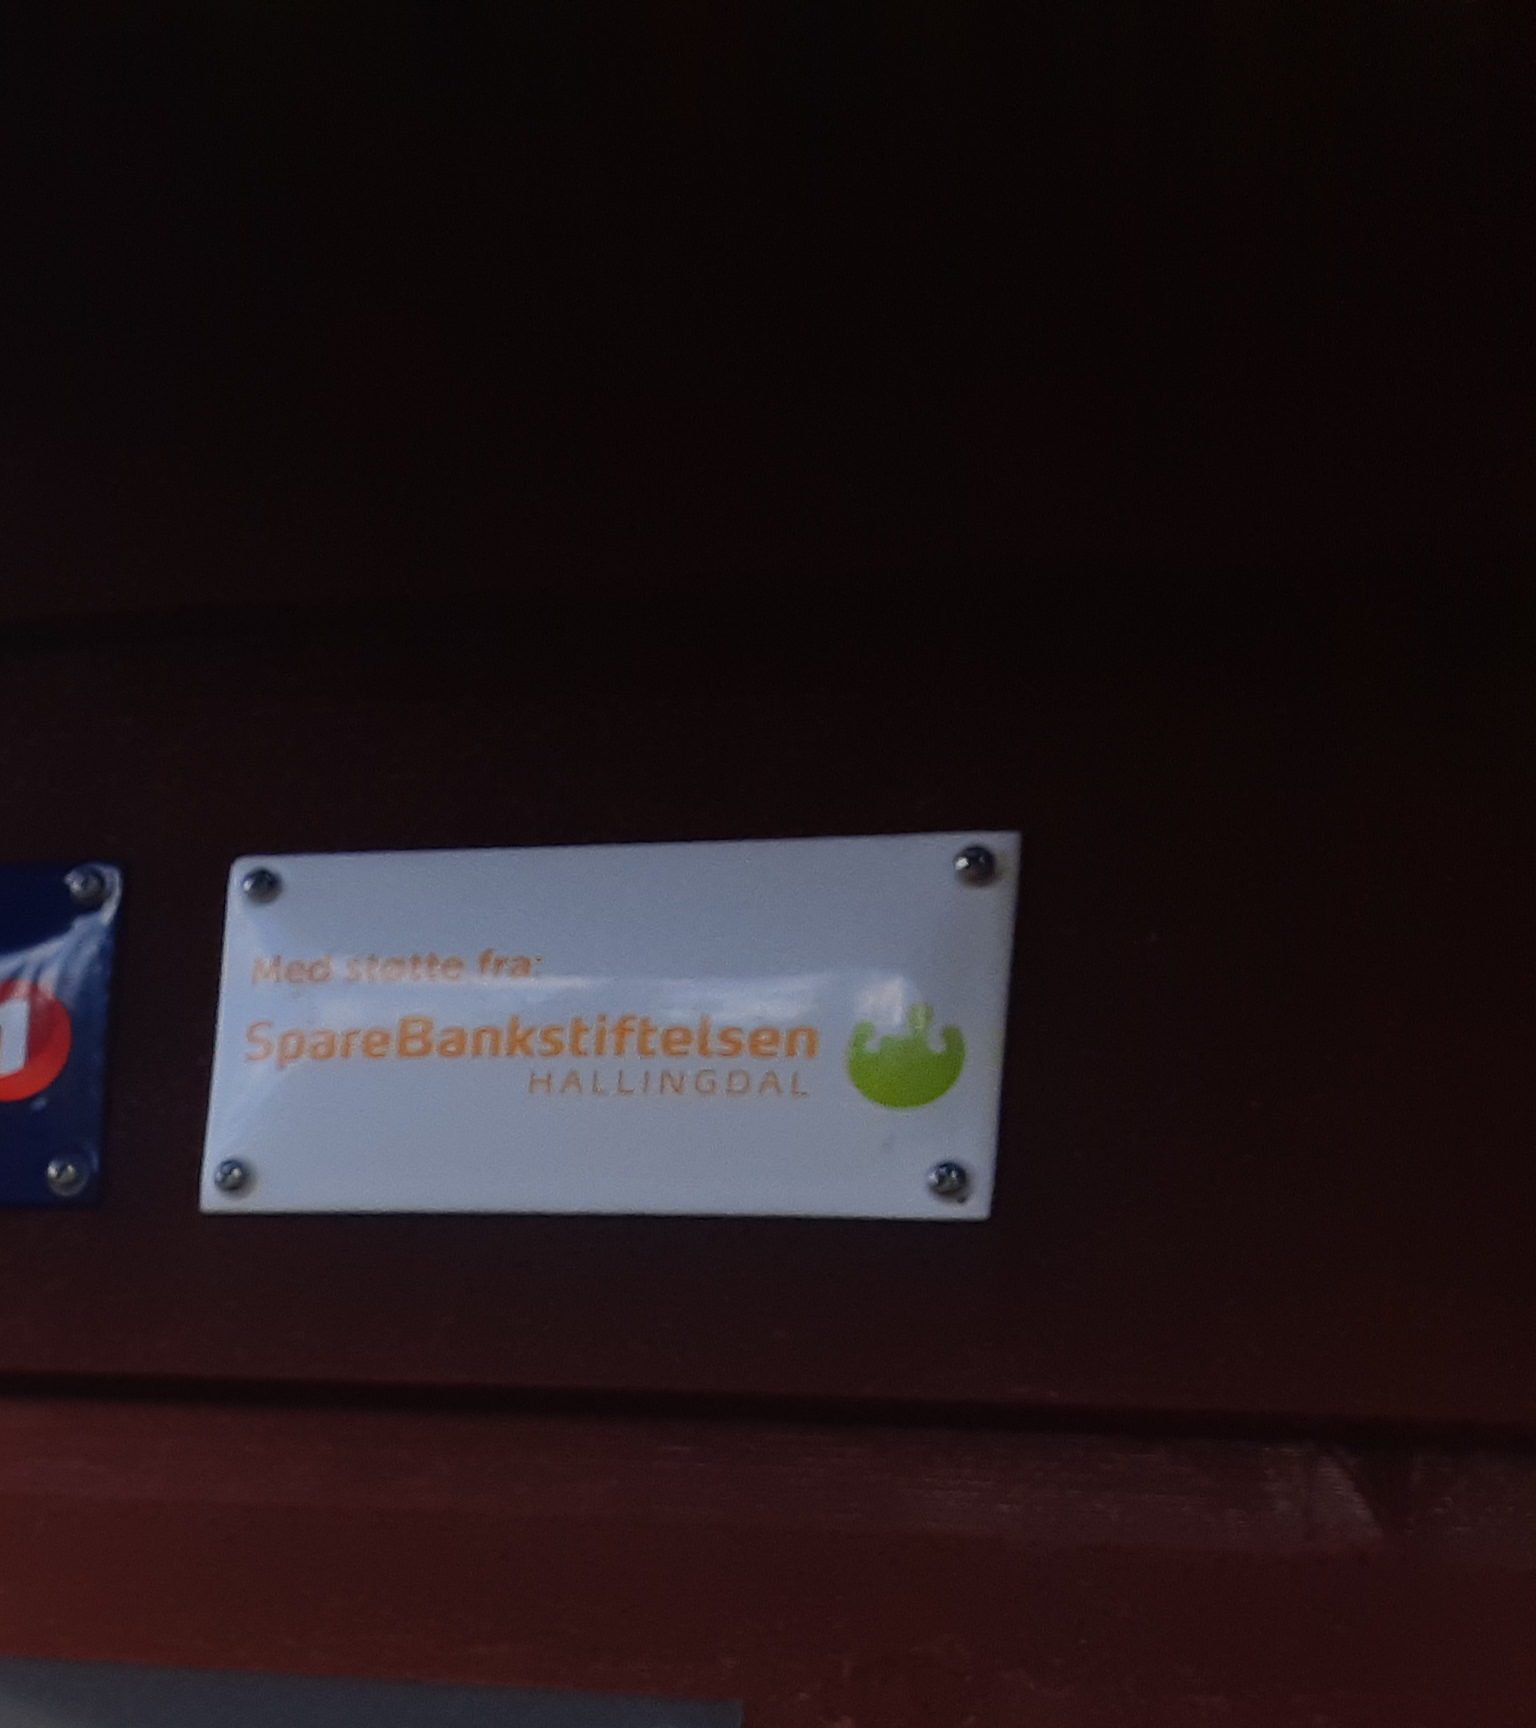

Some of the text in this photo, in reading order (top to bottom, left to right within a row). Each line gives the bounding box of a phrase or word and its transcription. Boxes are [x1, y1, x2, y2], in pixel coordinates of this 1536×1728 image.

[251, 955, 329, 986] Med
[345, 951, 465, 983] støtte
[244, 1013, 819, 1069] SpareBankstiftelsen
[529, 1069, 809, 1097] HALLINGDAL
